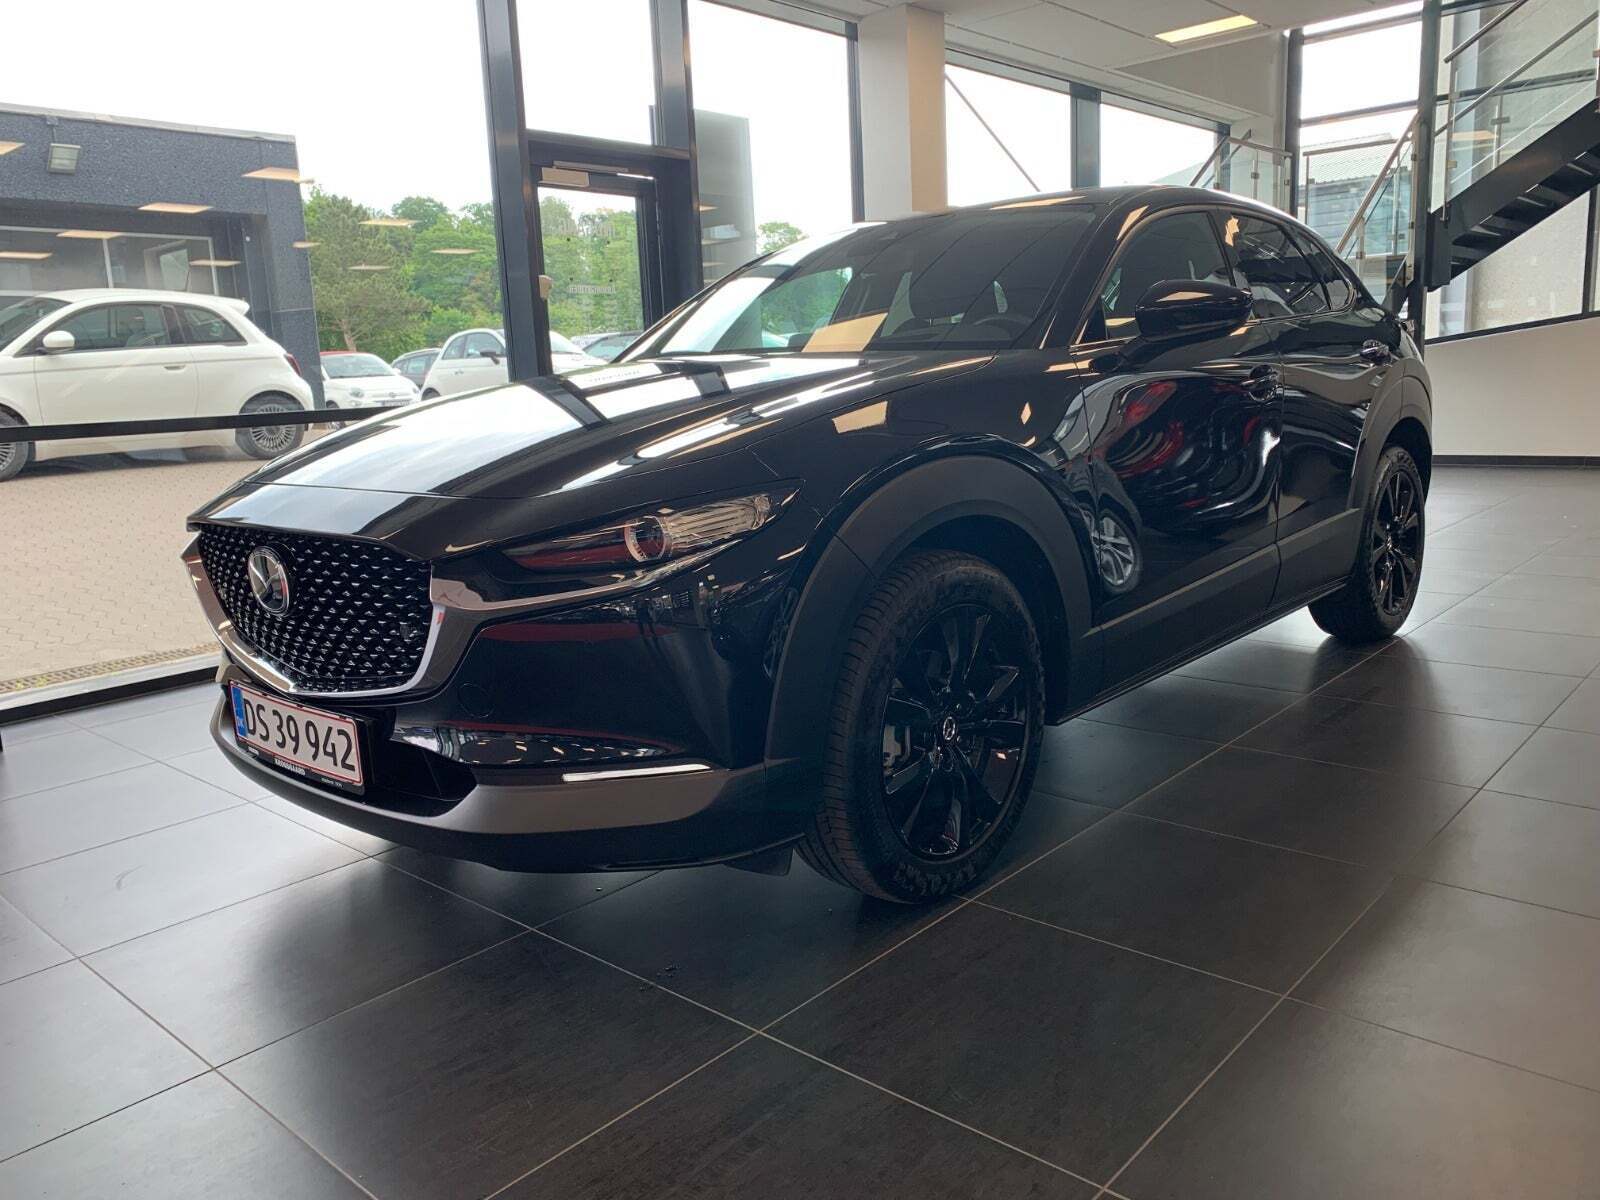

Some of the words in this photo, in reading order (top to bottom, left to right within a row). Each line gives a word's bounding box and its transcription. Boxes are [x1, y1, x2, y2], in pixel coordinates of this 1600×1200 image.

[244, 698, 270, 741] DS
[272, 709, 300, 755] 39
[305, 720, 356, 772] 942
